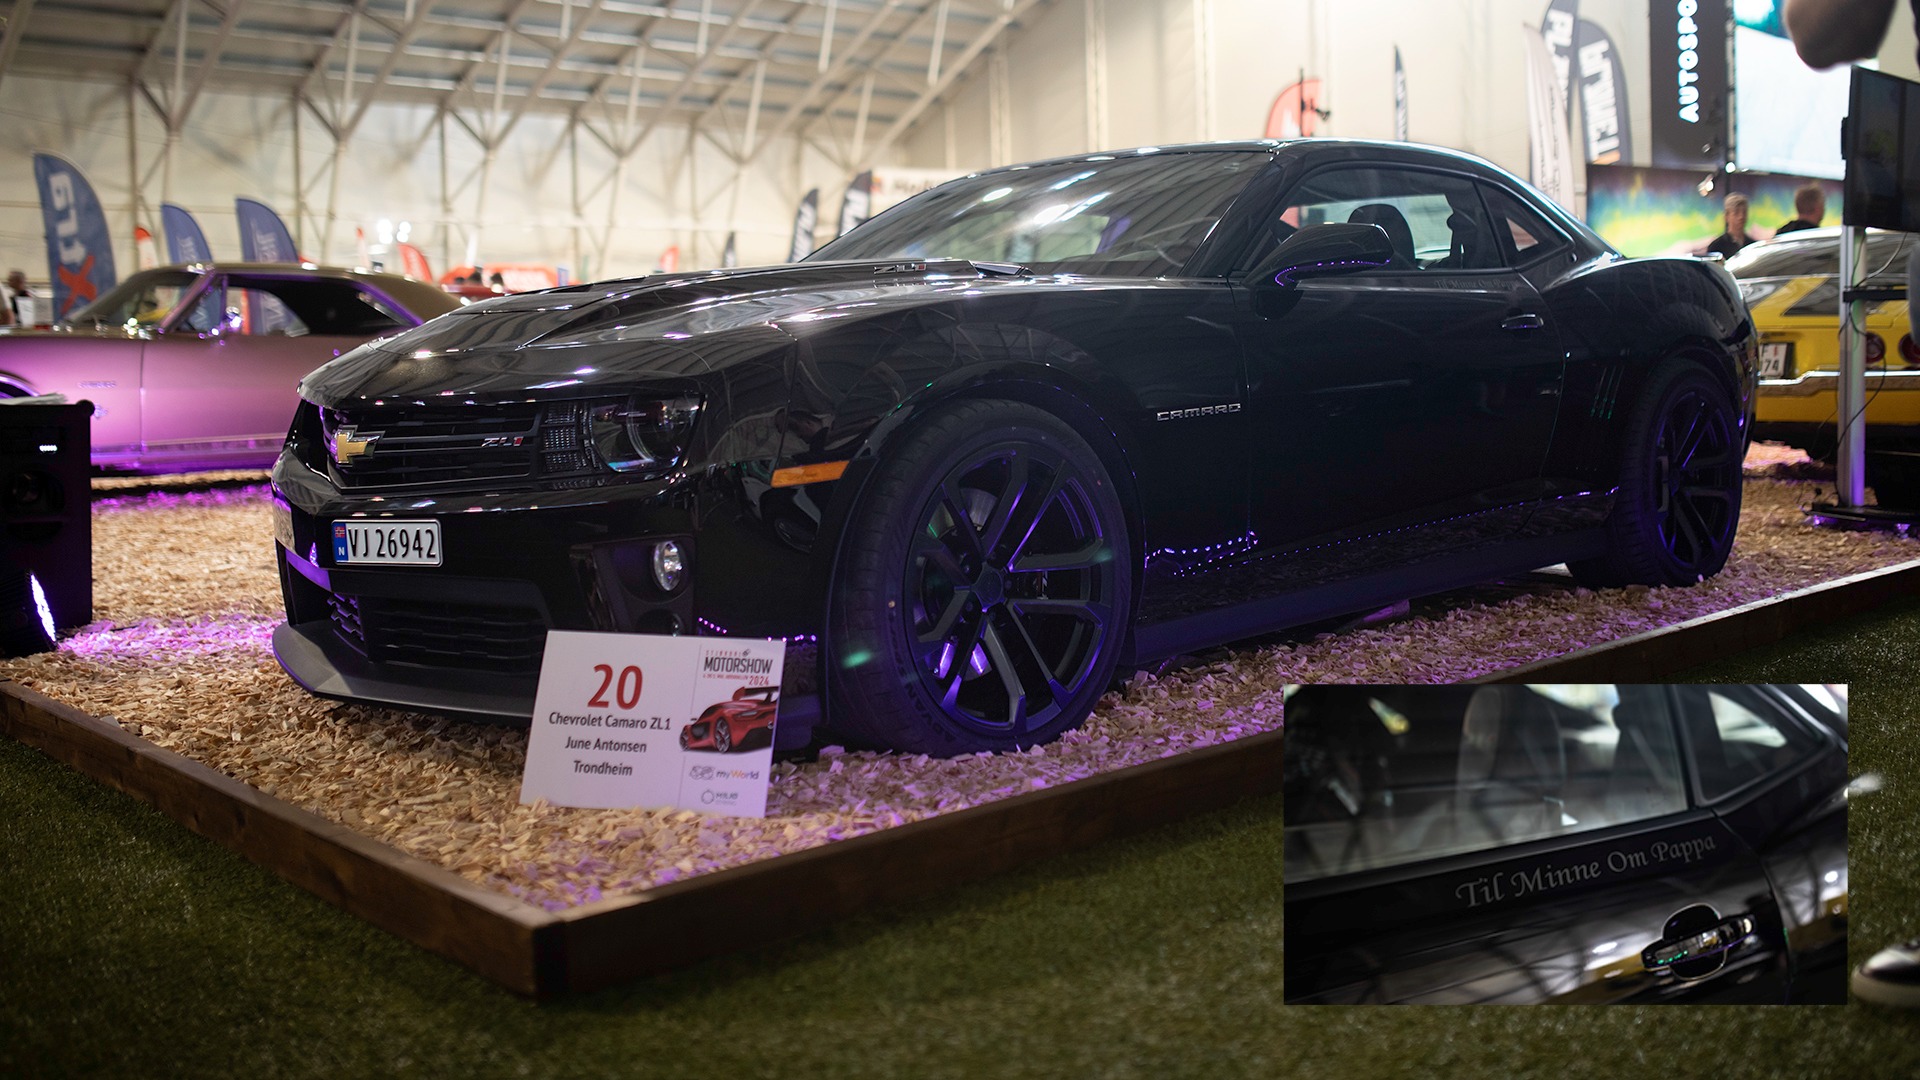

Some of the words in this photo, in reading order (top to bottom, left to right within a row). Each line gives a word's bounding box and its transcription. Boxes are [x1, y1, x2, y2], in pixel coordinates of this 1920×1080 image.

[1157, 403, 1241, 421] CAMARO
[481, 436, 524, 447] ZL1
[338, 546, 346, 556] N
[347, 528, 369, 558] VJ
[375, 528, 437, 558] 26942
[703, 656, 773, 674] MOTORSHOW
[587, 664, 643, 710] 20
[748, 675, 770, 686] 2024
[549, 711, 602, 727] Chevrolet
[605, 714, 648, 729] Camaro
[650, 717, 671, 730] ZL1
[565, 736, 591, 750] June
[593, 738, 647, 753] Antonsen
[573, 760, 633, 776] Trondheim
[716, 770, 760, 780] myWorld
[1455, 872, 1504, 908] Til
[1510, 862, 1602, 898] Minne
[1607, 850, 1649, 873] Om
[1649, 836, 1716, 863] Pappa
